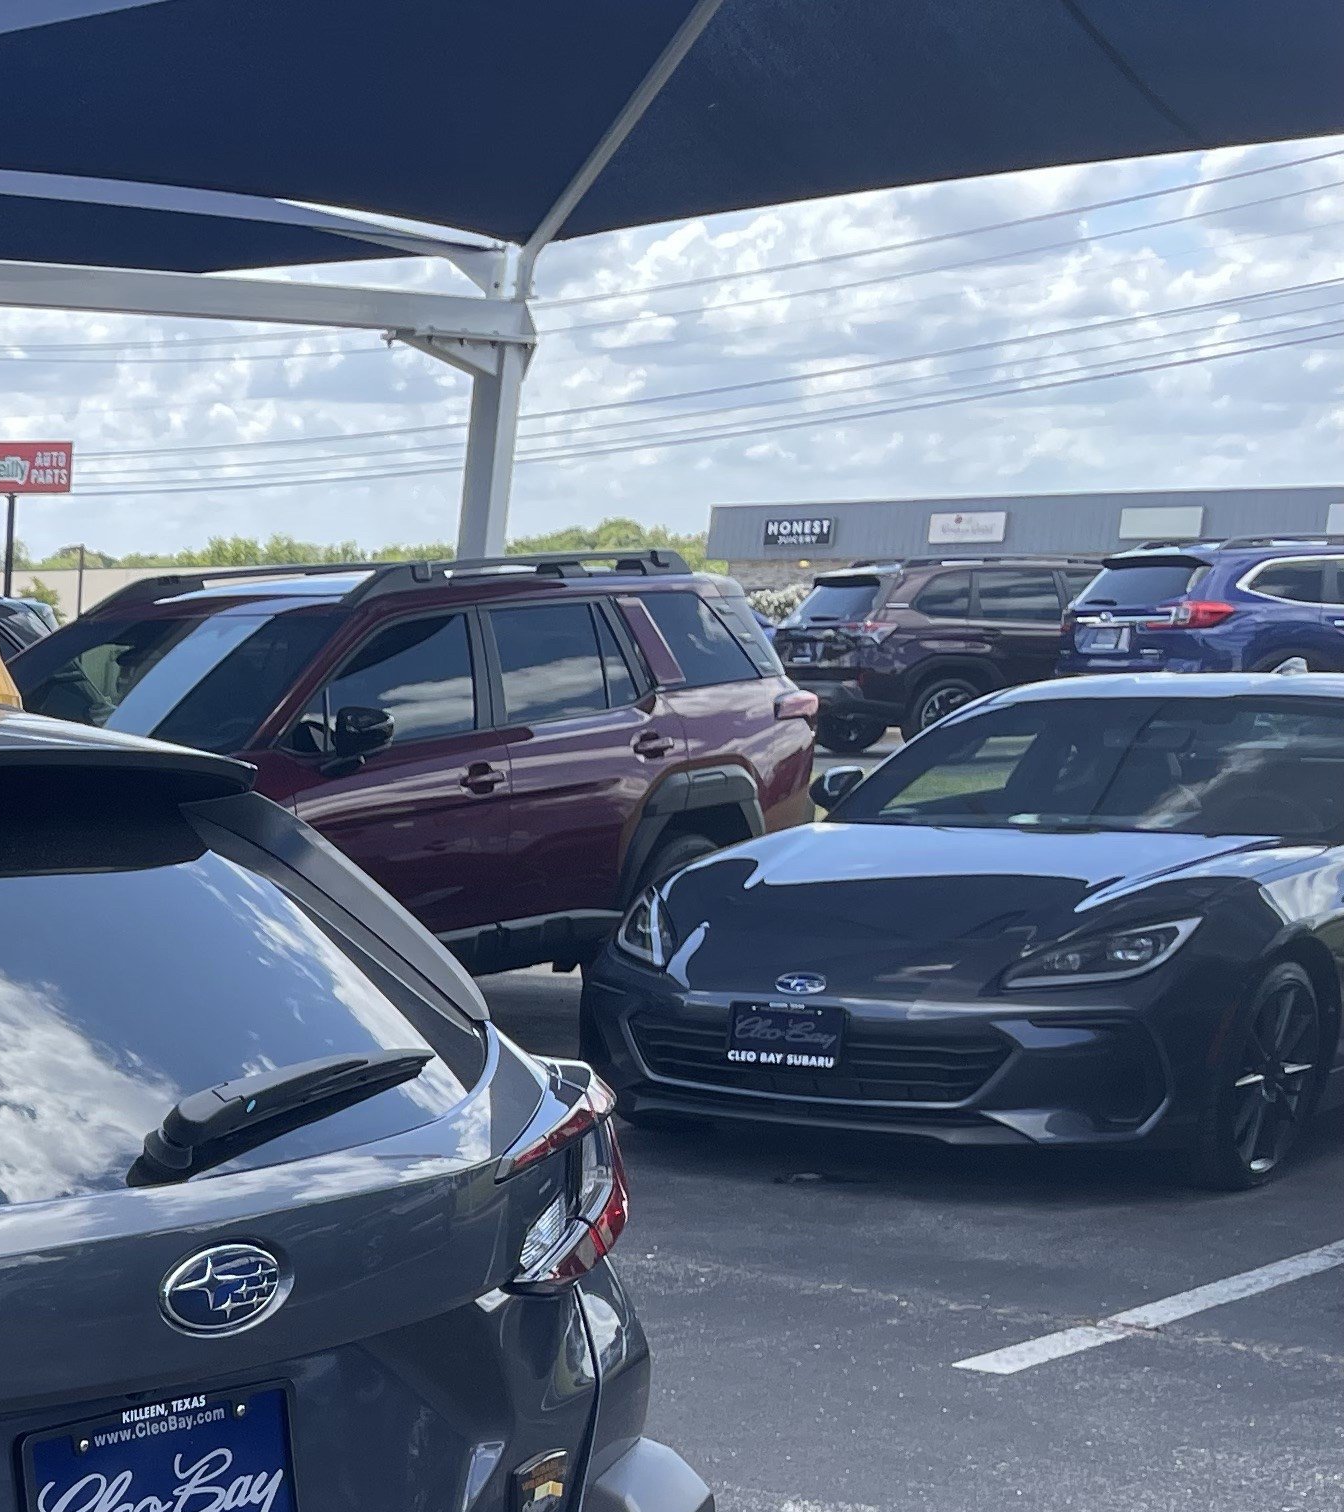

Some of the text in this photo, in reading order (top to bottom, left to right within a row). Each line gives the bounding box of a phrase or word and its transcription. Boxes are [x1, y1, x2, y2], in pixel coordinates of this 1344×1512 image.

[34, 452, 66, 467] AUTO
[31, 469, 68, 485] PARTS
[767, 520, 830, 535] HONEST
[727, 1050, 834, 1068] CLEO BAY SUBARU
[122, 1394, 207, 1424] KILLEEN, TEXAS
[94, 1407, 226, 1447] www.CleoBay.com
